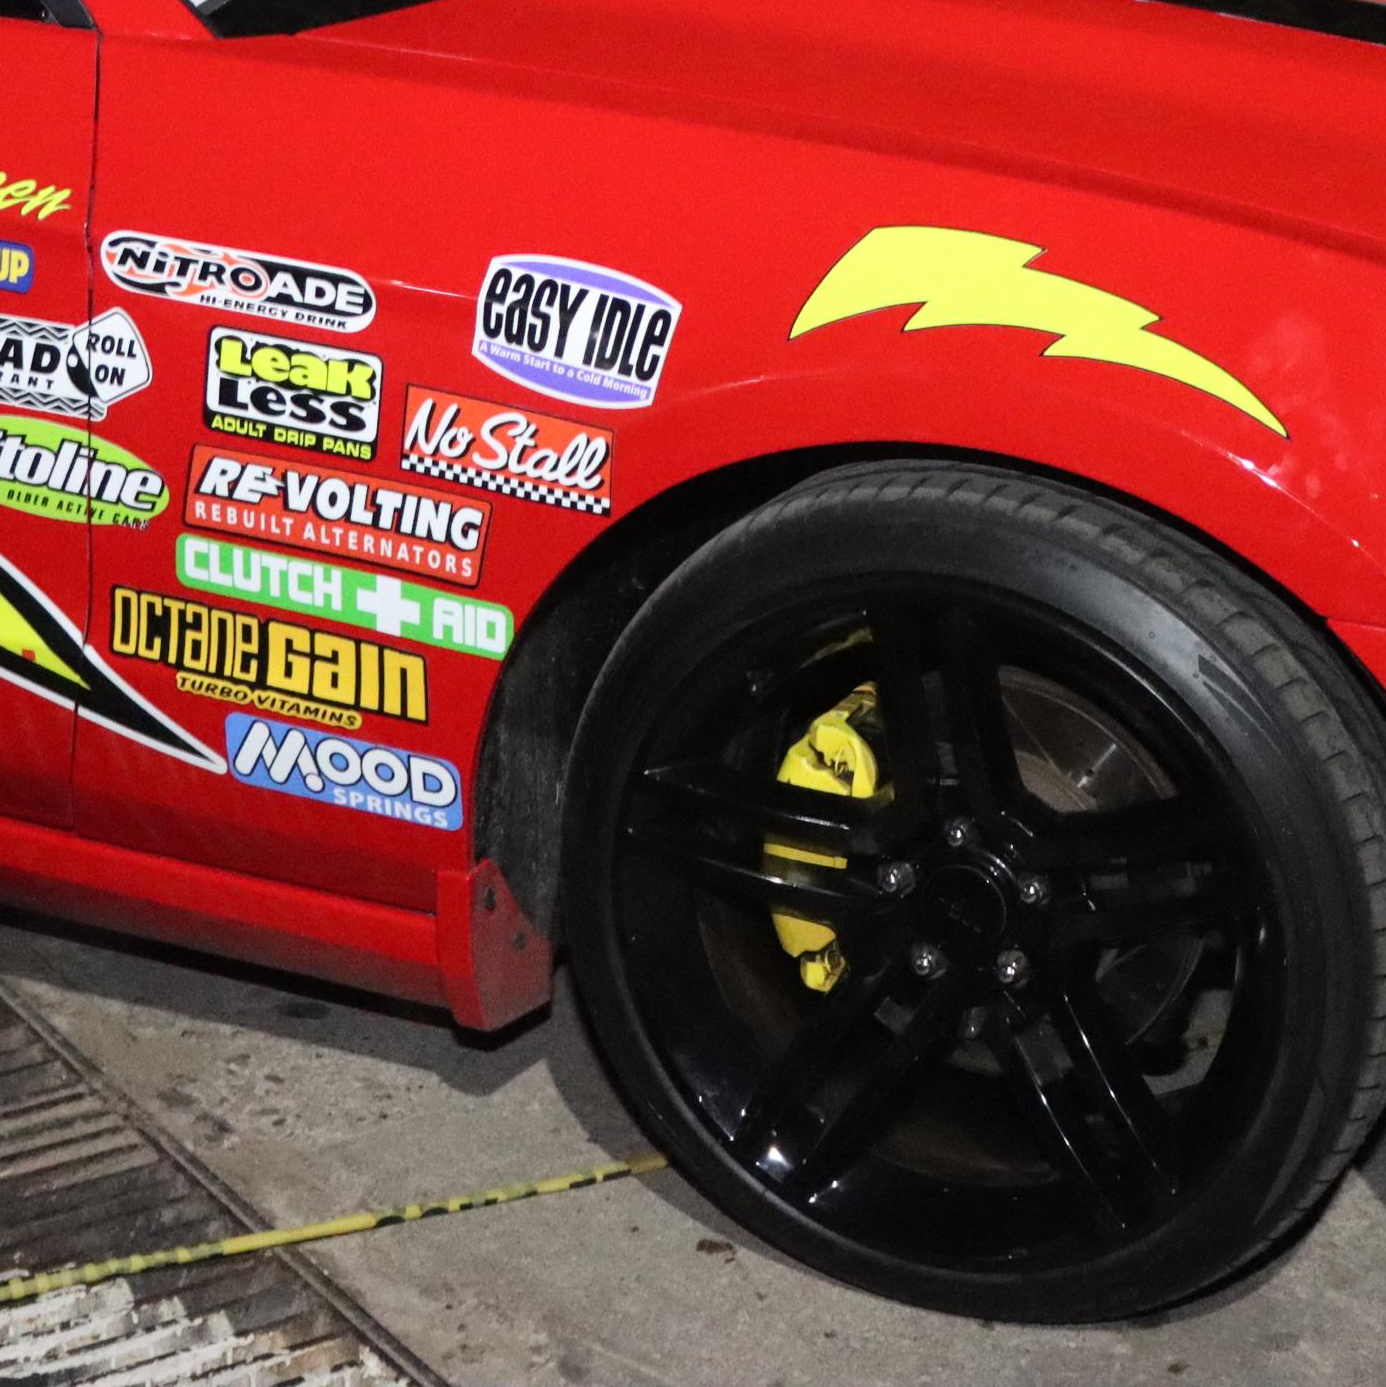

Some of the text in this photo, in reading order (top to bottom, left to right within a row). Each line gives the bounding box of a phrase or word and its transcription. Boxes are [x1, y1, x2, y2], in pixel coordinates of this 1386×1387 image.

[200, 294, 347, 330] HI-ENERGY DRINK
[86, 333, 137, 359] ROLL
[94, 364, 126, 386] ON
[490, 345, 521, 362] Warm
[523, 353, 551, 372] Start
[553, 363, 565, 375] to
[576, 370, 602, 386] Cold
[603, 377, 649, 399] Morning
[211, 415, 372, 460] ADULT DRIP PANS
[404, 397, 609, 490] No Stall
[7, 489, 49, 507] OLDER
[195, 500, 473, 578] REBUILT ALTERNATORS
[184, 538, 507, 653] CLUTCH AID
[178, 676, 359, 728] TURBO VITAMINS
[233, 719, 458, 808] MOOD
[333, 787, 450, 828] SPRINGS
